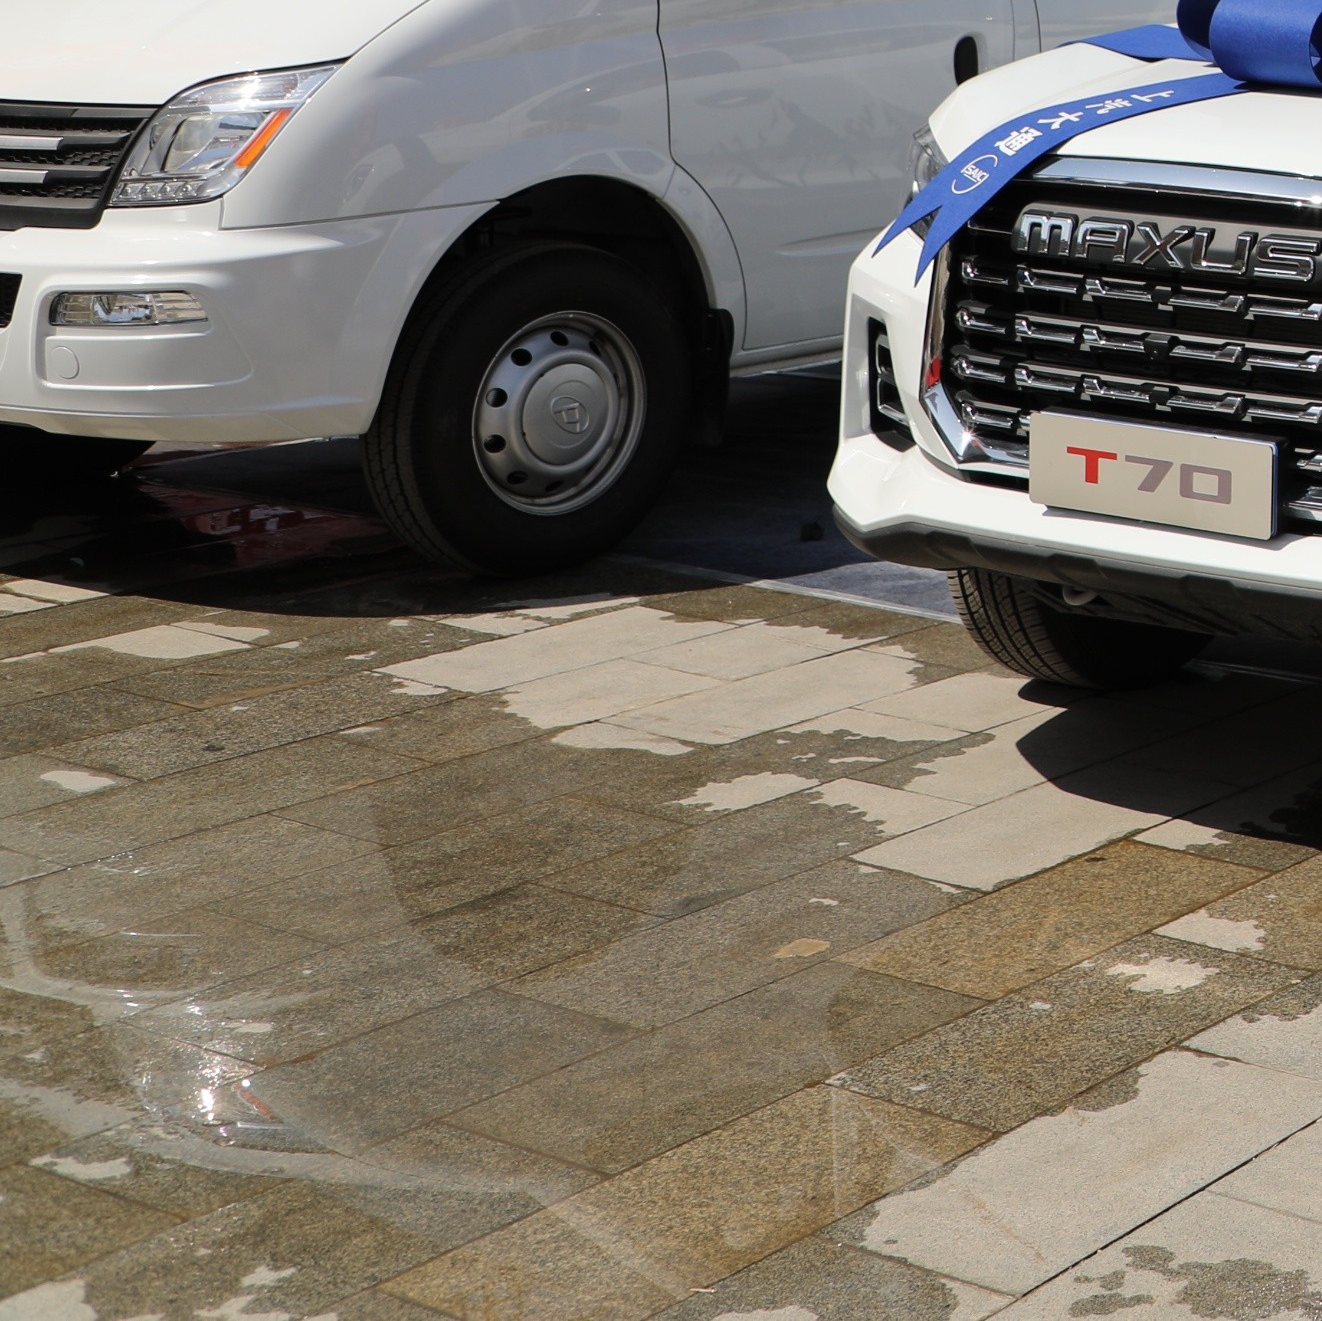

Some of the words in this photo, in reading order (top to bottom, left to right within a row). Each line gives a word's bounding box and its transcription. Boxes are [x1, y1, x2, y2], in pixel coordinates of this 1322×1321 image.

[995, 90, 1175, 156] 上汽大通
[1066, 446, 1232, 505] T70
